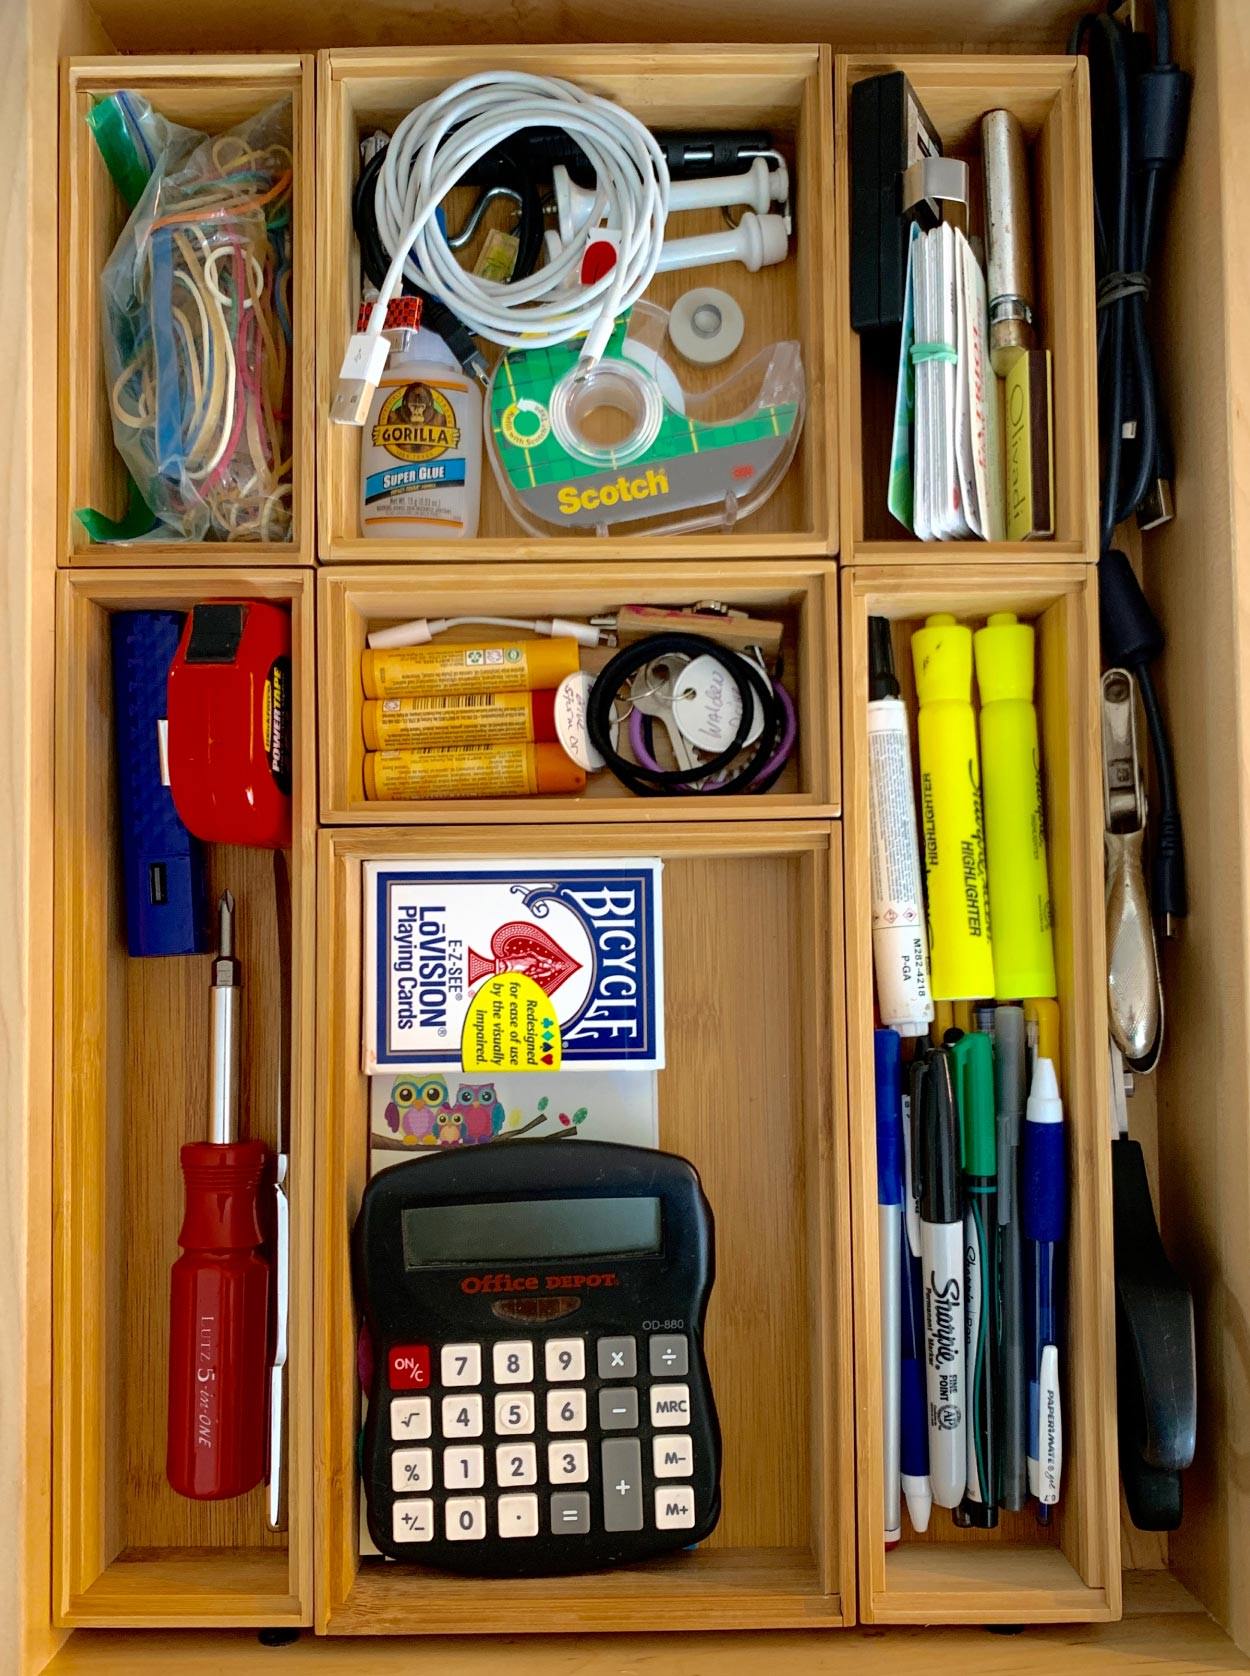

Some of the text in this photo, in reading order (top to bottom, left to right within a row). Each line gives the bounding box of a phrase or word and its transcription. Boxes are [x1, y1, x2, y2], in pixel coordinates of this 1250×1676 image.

[382, 427, 448, 444] GORILLA
[1010, 384, 1026, 519] Olivadi
[383, 470, 415, 489] SUPER
[418, 466, 445, 481] GLUE
[557, 469, 670, 515] Scotch
[923, 773, 938, 866] HIGHLIGHTER
[961, 840, 981, 937] HIGHLIGHTER
[394, 906, 418, 1029] Playing Cards
[561, 886, 637, 1040] BICYCLE
[902, 955, 911, 982] P-GA
[913, 938, 925, 997] M282-4218
[490, 983, 504, 1065] by the visually
[510, 982, 521, 1065] for ease of use
[523, 1000, 538, 1065] Redesigned
[473, 1009, 487, 1065] impaired.
[461, 1274, 539, 1294] Office
[642, 1320, 684, 1331] OD-880
[931, 1270, 960, 1367] Sharpie
[200, 1316, 214, 1361] LUTZ
[454, 1357, 468, 1376] 7
[506, 1355, 520, 1374] 8
[558, 1351, 572, 1370] 9
[939, 1374, 949, 1402] POINT
[456, 1408, 470, 1427] 4
[508, 1405, 521, 1425] 5
[560, 1402, 574, 1421] 6
[656, 1400, 687, 1413] MRC
[1047, 1389, 1055, 1428] PAPER
[664, 1453, 686, 1465] M-
[1047, 1433, 1055, 1464] MATE
[405, 1465, 420, 1482] %
[460, 1459, 469, 1478] 1
[510, 1458, 524, 1477] 2
[563, 1454, 577, 1474] 3
[460, 1511, 473, 1530] 0
[665, 1503, 689, 1516] M+
